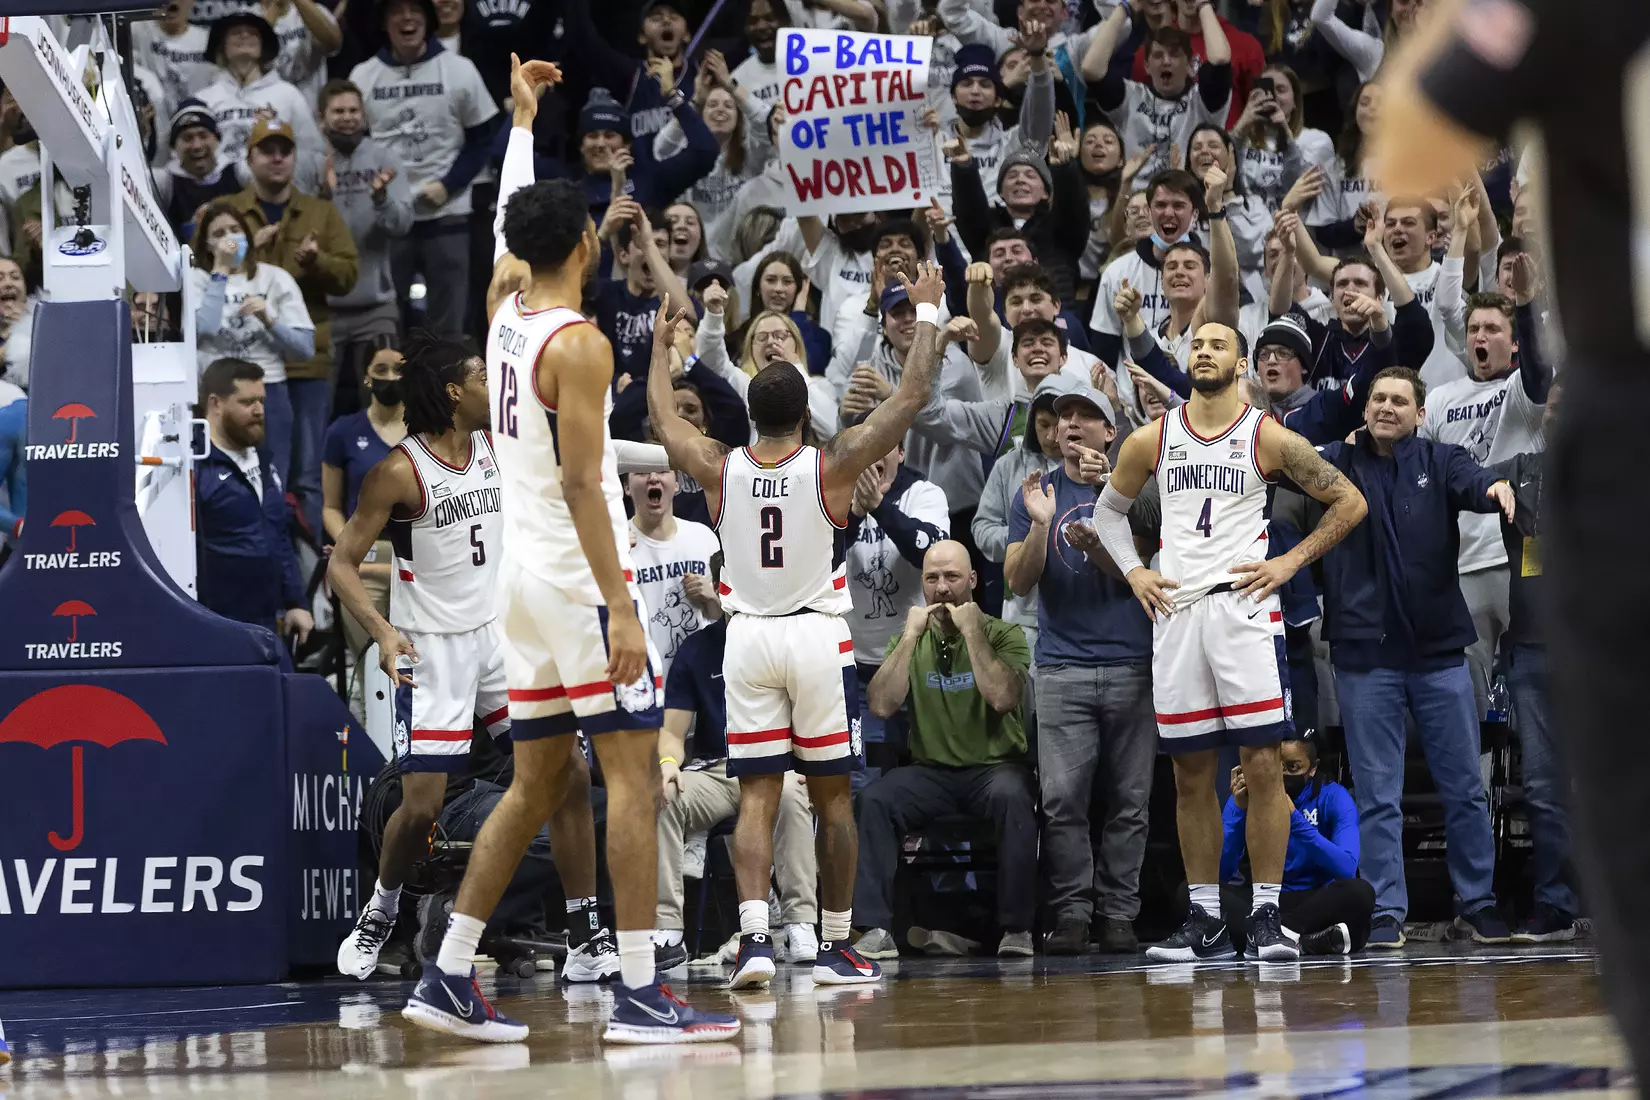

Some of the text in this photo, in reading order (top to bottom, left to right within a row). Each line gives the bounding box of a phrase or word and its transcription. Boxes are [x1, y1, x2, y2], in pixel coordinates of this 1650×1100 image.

[786, 33, 923, 76] B-BALL
[783, 69, 926, 115] CAPITAL
[791, 111, 909, 150] OF THE
[786, 151, 920, 203] WORLD!
[498, 361, 519, 440] 12
[1446, 405, 1474, 424] BEAT
[25, 442, 119, 461] TRAVELERS
[752, 477, 789, 499] COLE
[1167, 464, 1247, 496] CONNECTICUT
[760, 506, 784, 568] 2
[1196, 497, 1212, 538] 4
[470, 523, 486, 566] 5
[666, 560, 706, 579] XAVIER
[25, 641, 122, 660] TRAVELERS
